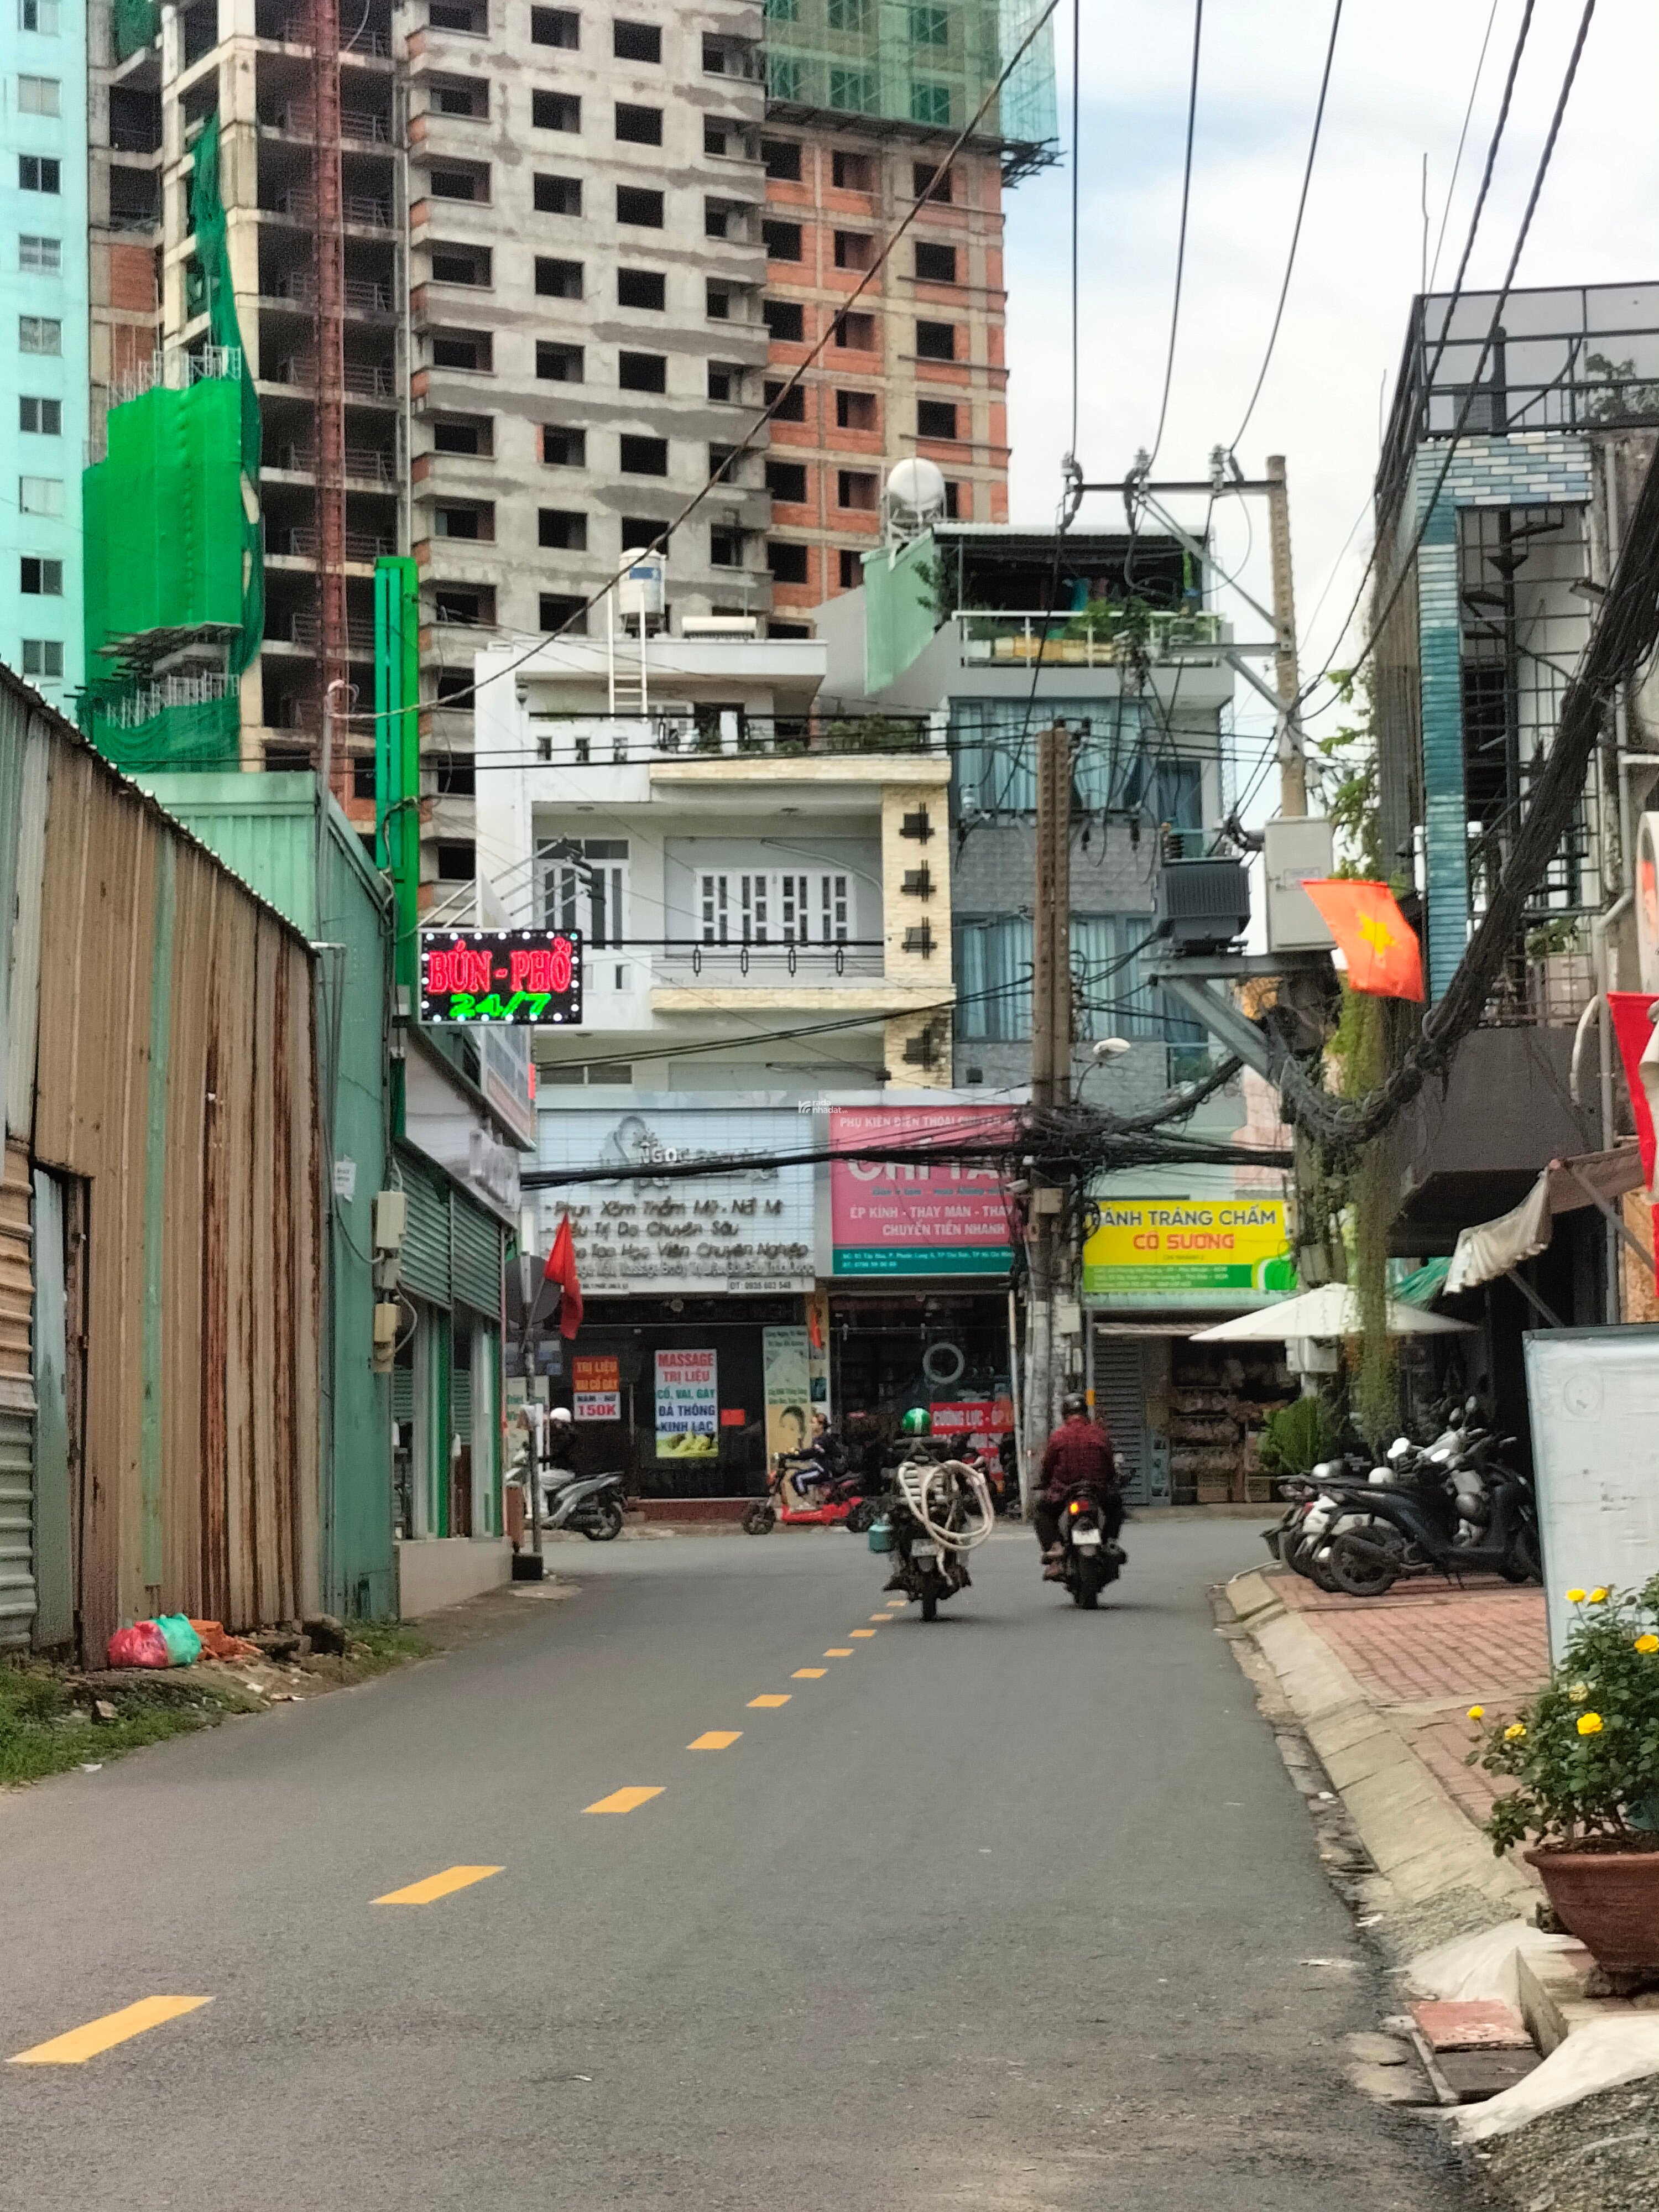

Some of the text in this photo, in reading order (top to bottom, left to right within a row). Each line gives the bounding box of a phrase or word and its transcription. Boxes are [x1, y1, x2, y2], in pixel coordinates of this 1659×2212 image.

[427, 939, 492, 993] BÚN
[510, 937, 572, 993] PHỞ
[449, 991, 551, 1018] 24/7
[869, 1204, 898, 1218] KÍNH
[910, 1206, 941, 1218] THAY
[1147, 1206, 1213, 1226] TRÁNG
[1218, 1204, 1276, 1225] CHẤM
[964, 1223, 1005, 1234] NHANH
[1133, 1230, 1160, 1251] CÔ
[658, 1353, 713, 1366] MASSAGE
[664, 1369, 710, 1384] TRỊ LIỆU
[578, 1404, 616, 1416] 150K
[677, 1403, 715, 1416] THÔNG
